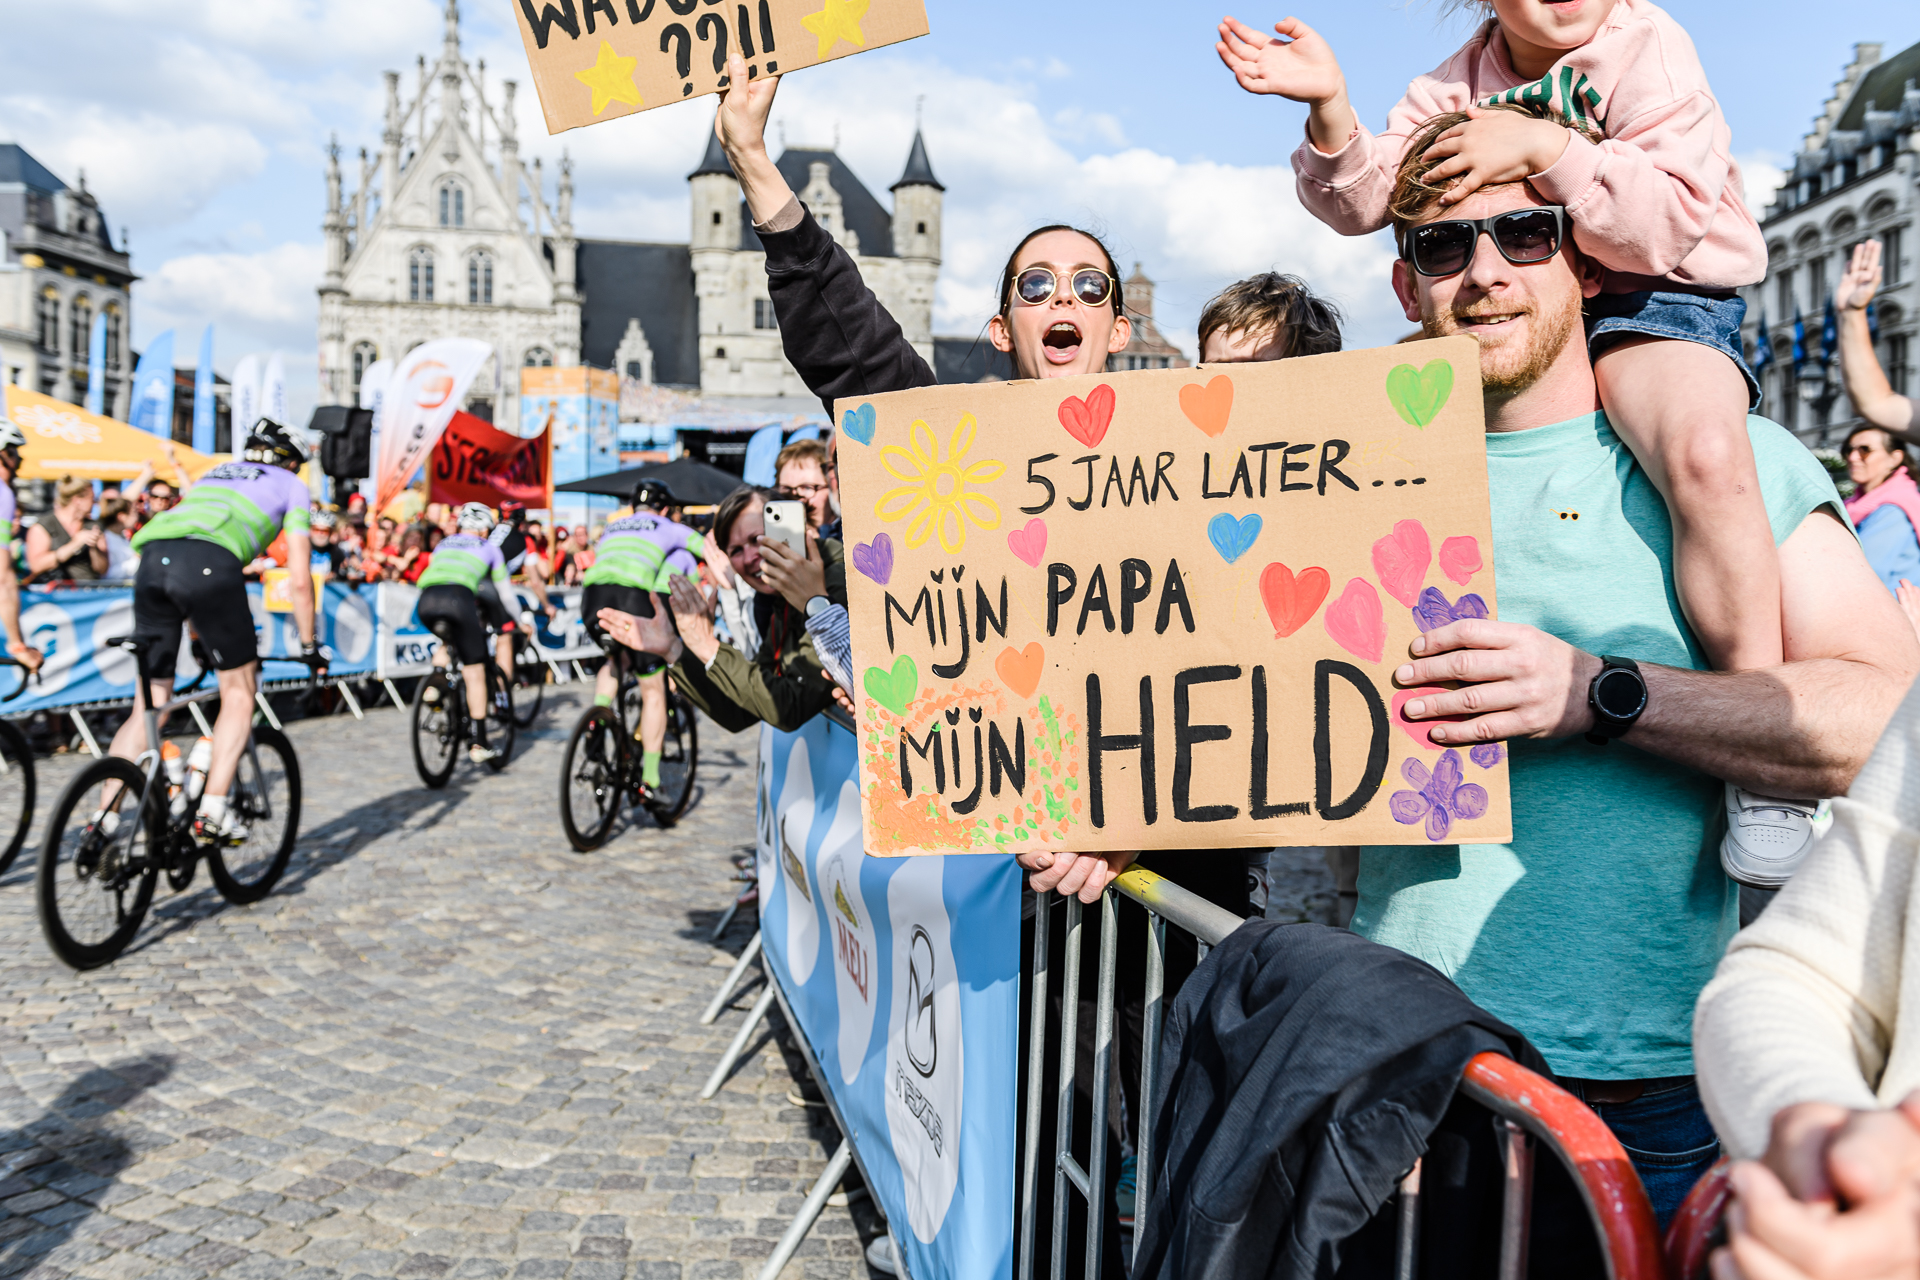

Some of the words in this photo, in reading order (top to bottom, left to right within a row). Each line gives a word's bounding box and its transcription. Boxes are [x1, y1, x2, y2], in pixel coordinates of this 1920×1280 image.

[660, 0, 778, 97] ??!!
[1020, 453, 1058, 514] 5
[1068, 451, 1179, 511] JAAR
[1047, 557, 1196, 637] PAPA
[1085, 658, 1390, 829] HELD
